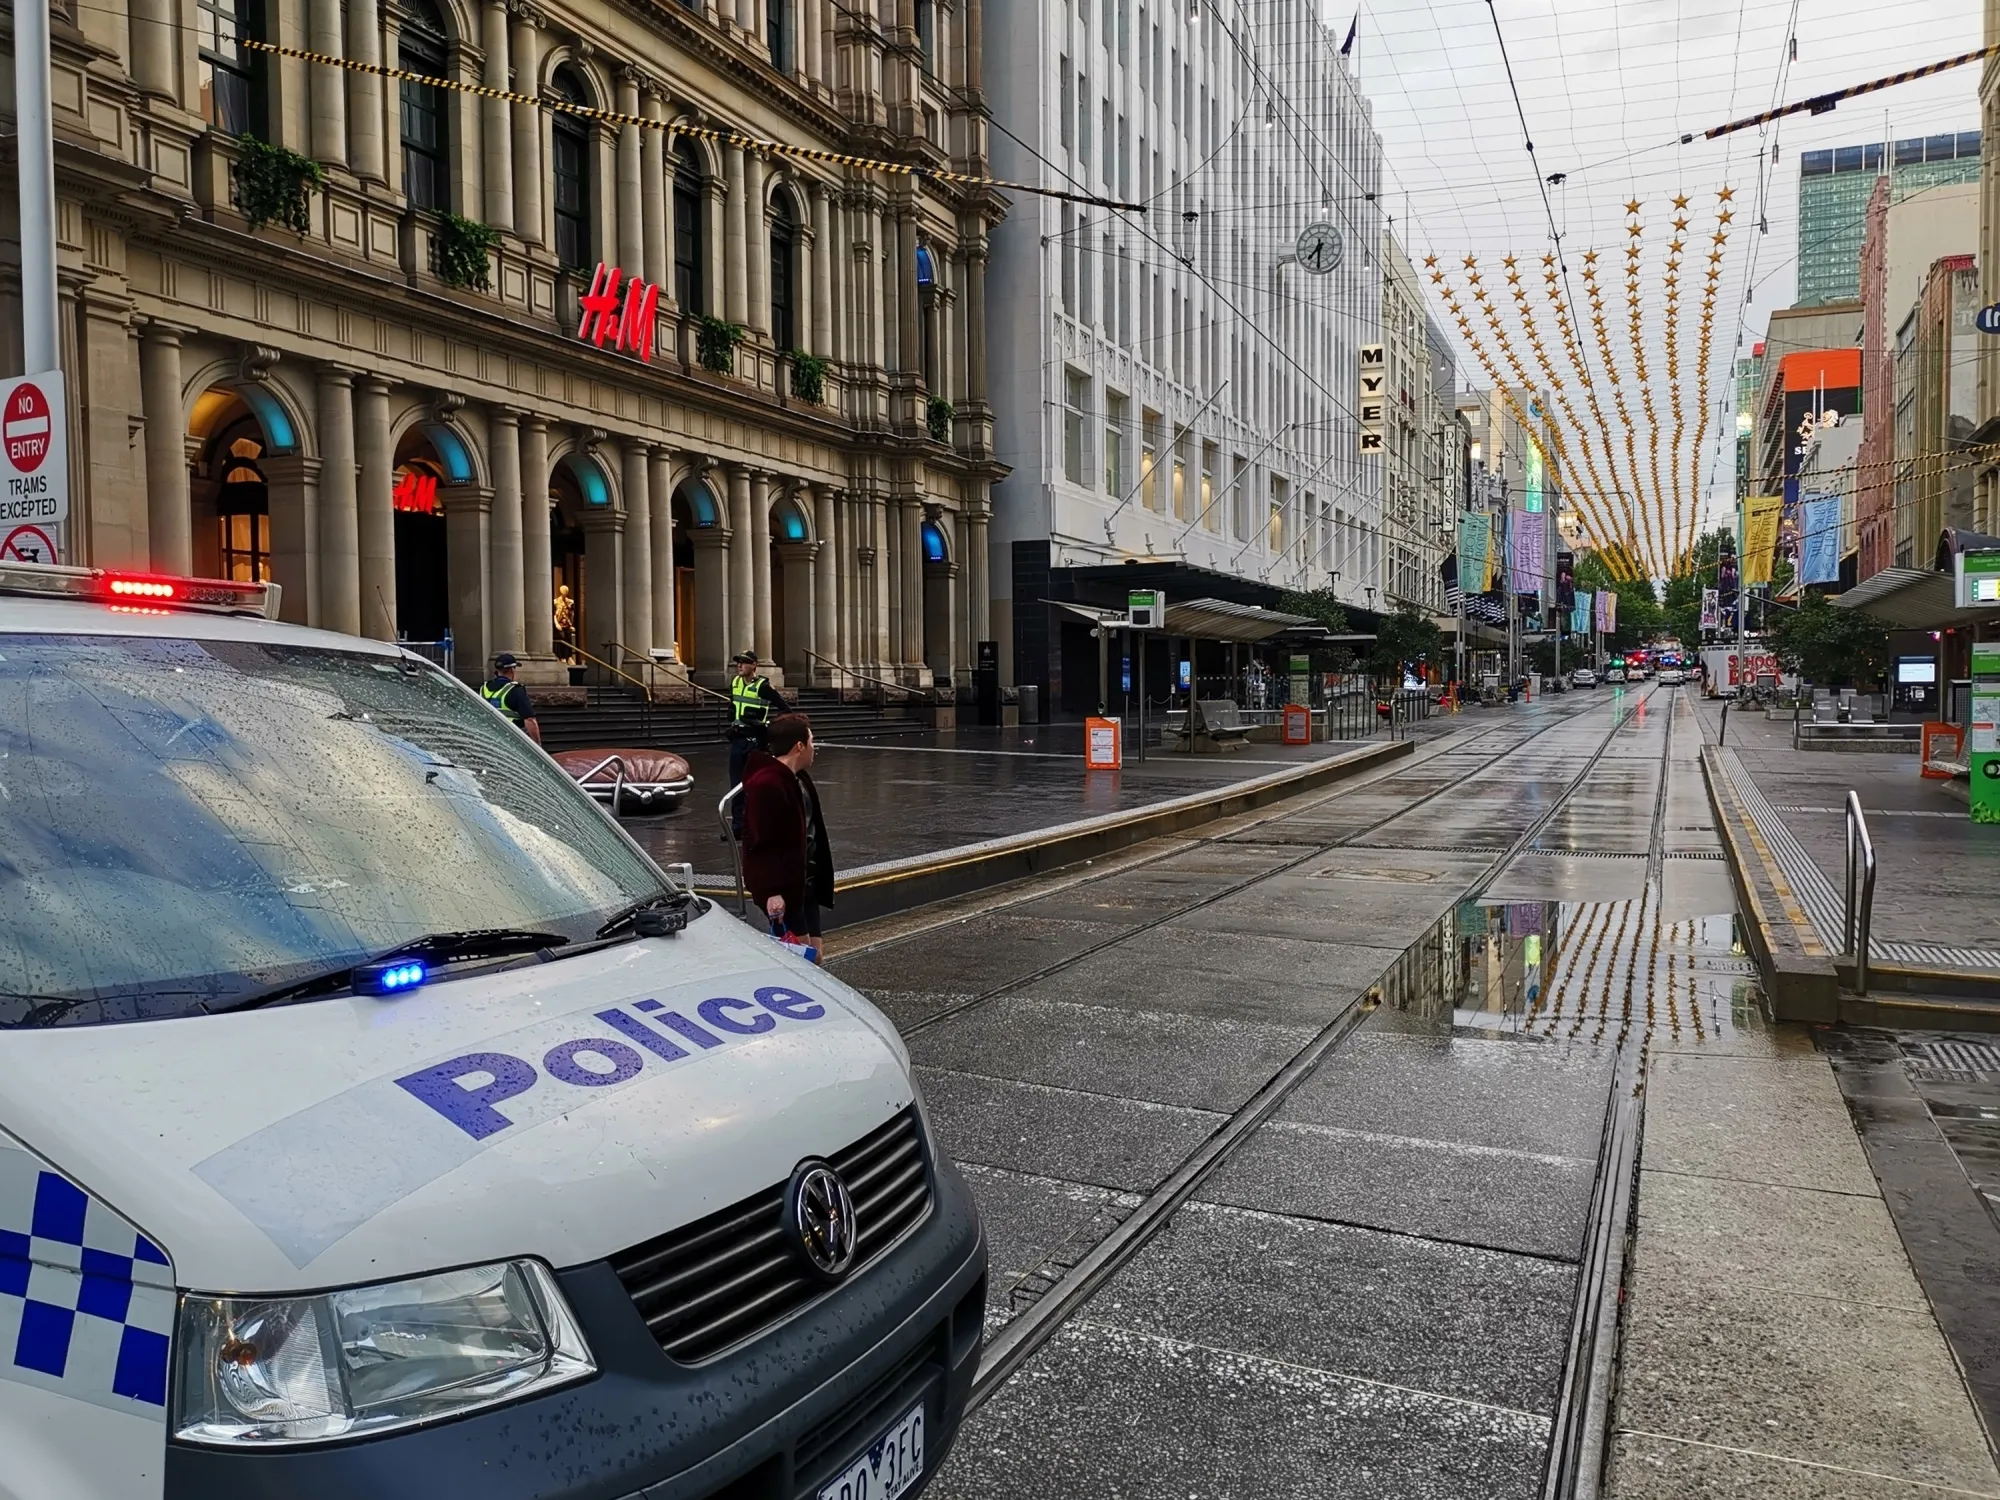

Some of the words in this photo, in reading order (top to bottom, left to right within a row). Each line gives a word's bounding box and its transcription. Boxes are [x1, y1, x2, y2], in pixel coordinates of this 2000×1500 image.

[577, 262, 659, 363] H&M
[18, 396, 33, 415] NO
[1361, 348, 1383, 449] MYER
[11, 438, 46, 459] ENTRY
[1446, 430, 1454, 476] DAVID
[0, 497, 57, 519] EXCEPTED
[9, 475, 47, 496] TRAMS
[1444, 479, 1454, 526] JONES
[1748, 501, 1764, 560] MELBOUNE
[1762, 501, 1777, 536] CARNIAL
[1810, 500, 1826, 558] MELOURN
[1728, 655, 1778, 669] SHOO
[1728, 668, 1784, 686] ROK
[393, 986, 826, 1141] Police
[885, 1416, 921, 1490] 3FC
